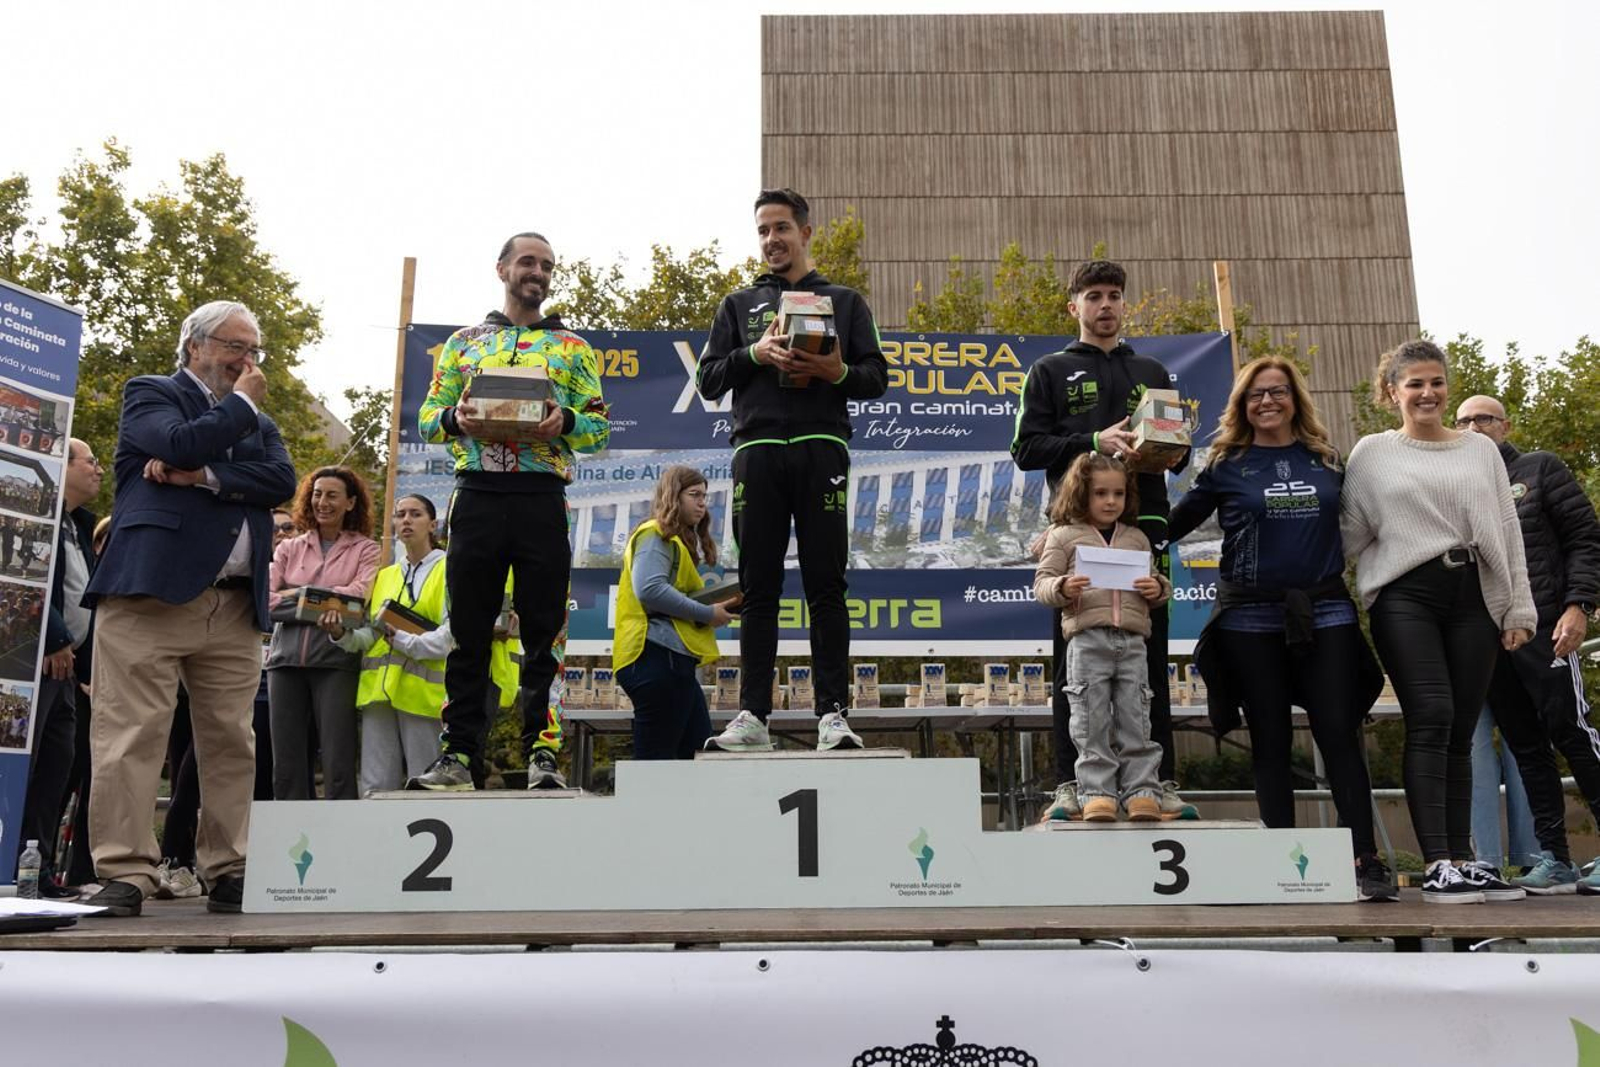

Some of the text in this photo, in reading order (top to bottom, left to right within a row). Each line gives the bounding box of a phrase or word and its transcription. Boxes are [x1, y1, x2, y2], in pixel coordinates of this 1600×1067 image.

[3, 302, 33, 320] de la
[0, 332, 40, 353] ración
[4, 317, 66, 347] Caminata
[880, 341, 1022, 368] RRERA
[20, 363, 28, 372] y
[28, 366, 61, 381] valores
[887, 368, 1027, 395] PULAR
[847, 400, 1022, 416] gran caminat
[863, 417, 972, 450] Integración
[577, 465, 606, 480] ina
[612, 465, 636, 480] de
[1264, 481, 1317, 497] 25
[778, 789, 819, 877] 1
[402, 818, 454, 892] 2
[1151, 839, 1190, 896] 3
[922, 882, 952, 890] Municipal
